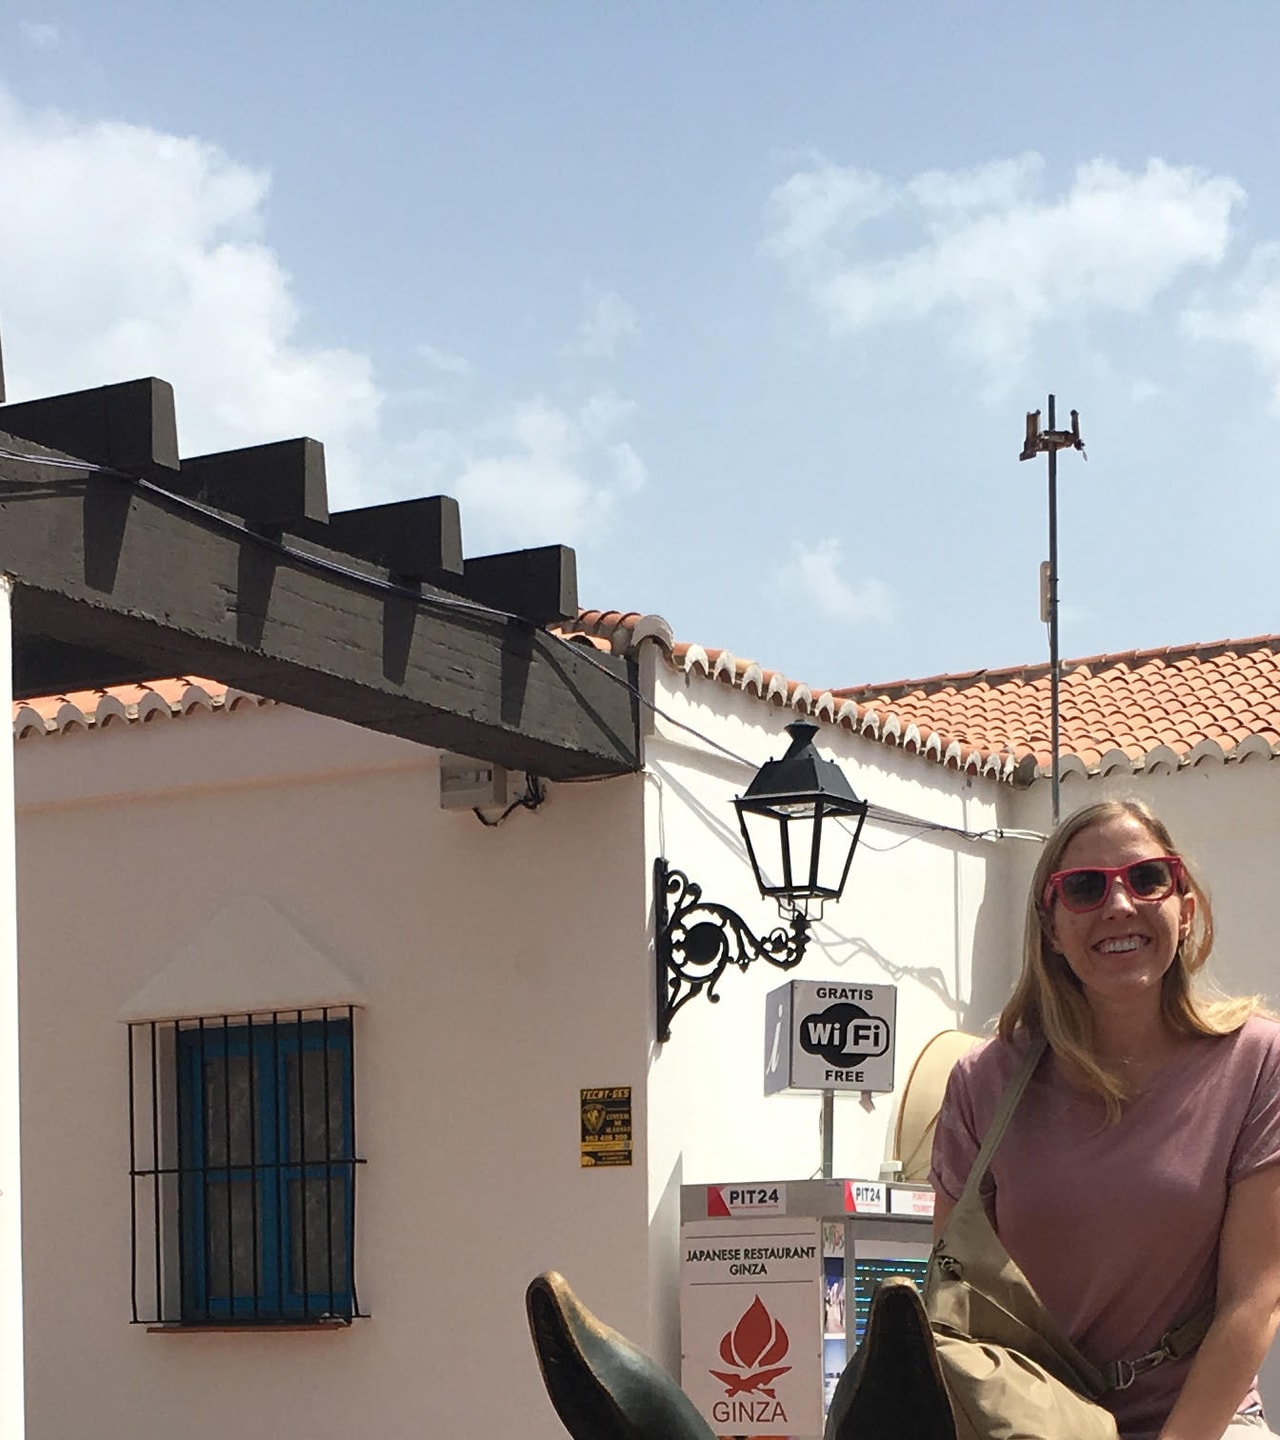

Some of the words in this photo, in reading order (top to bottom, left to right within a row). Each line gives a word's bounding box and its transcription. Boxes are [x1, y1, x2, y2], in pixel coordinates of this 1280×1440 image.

[816, 987, 873, 1000] GRATIS
[824, 1070, 865, 1082] FREE
[729, 1188, 779, 1205] PIT24
[855, 1187, 881, 1202] PIT24
[686, 1248, 741, 1262] JAPANESE
[743, 1246, 817, 1260] RESTAURANT
[729, 1263, 768, 1276] GINZA
[712, 1401, 788, 1423] GINZA
